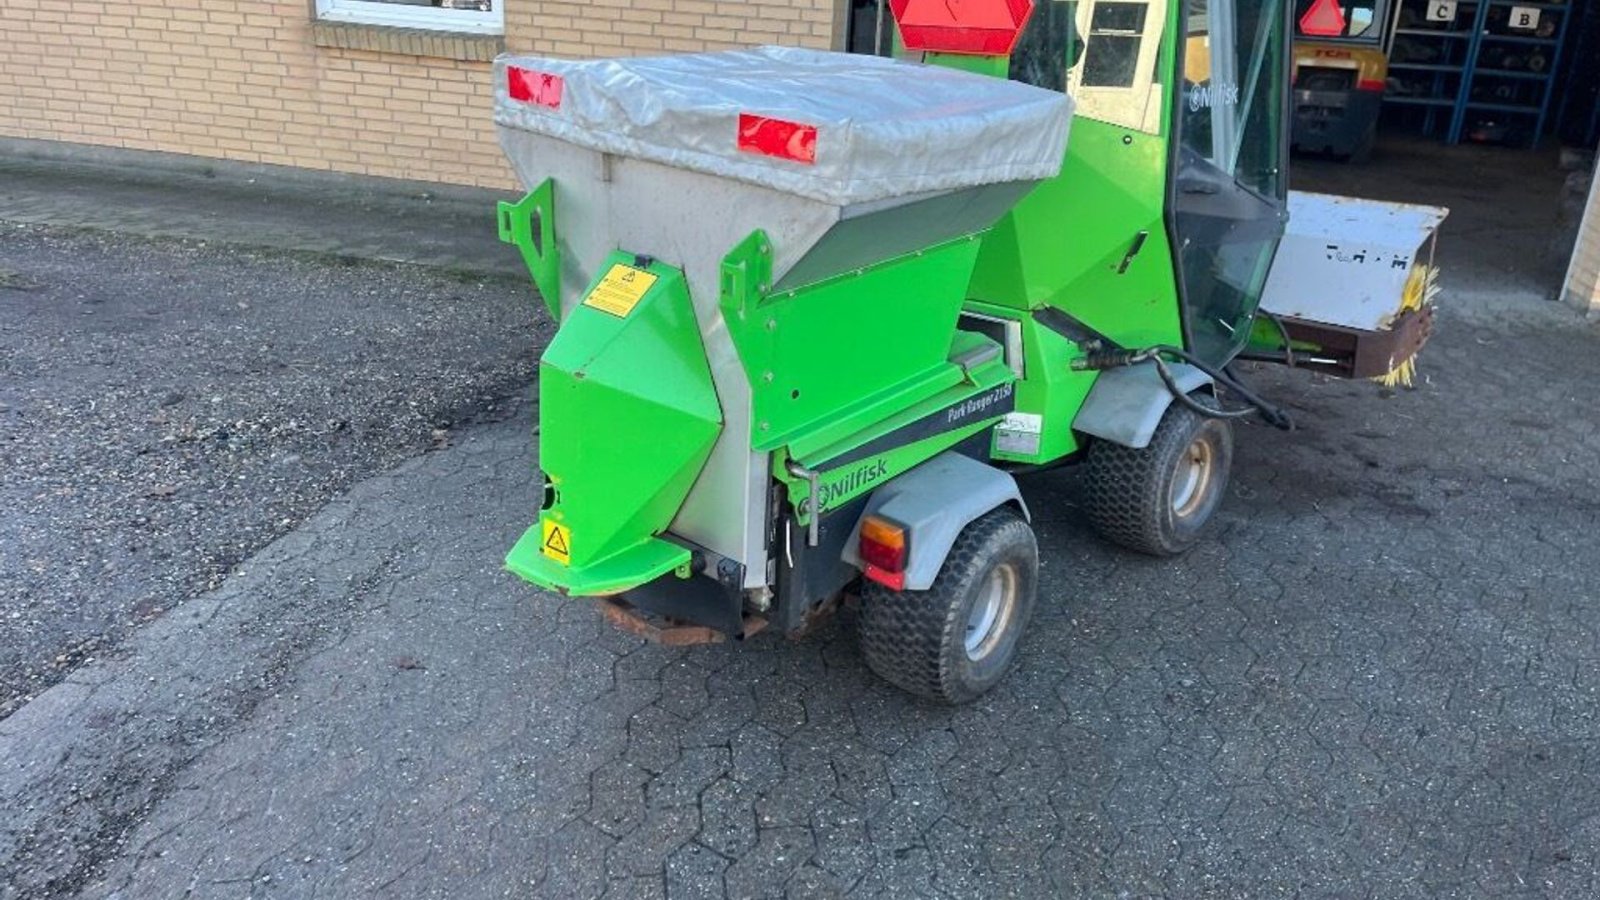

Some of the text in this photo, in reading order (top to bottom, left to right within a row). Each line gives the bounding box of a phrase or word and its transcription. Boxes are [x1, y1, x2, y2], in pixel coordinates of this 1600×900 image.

[1436, 5, 1448, 18] C
[1518, 13, 1530, 26] B
[948, 402, 966, 423] Park
[967, 394, 994, 412] Ranger
[831, 459, 888, 500] Nilfisk
